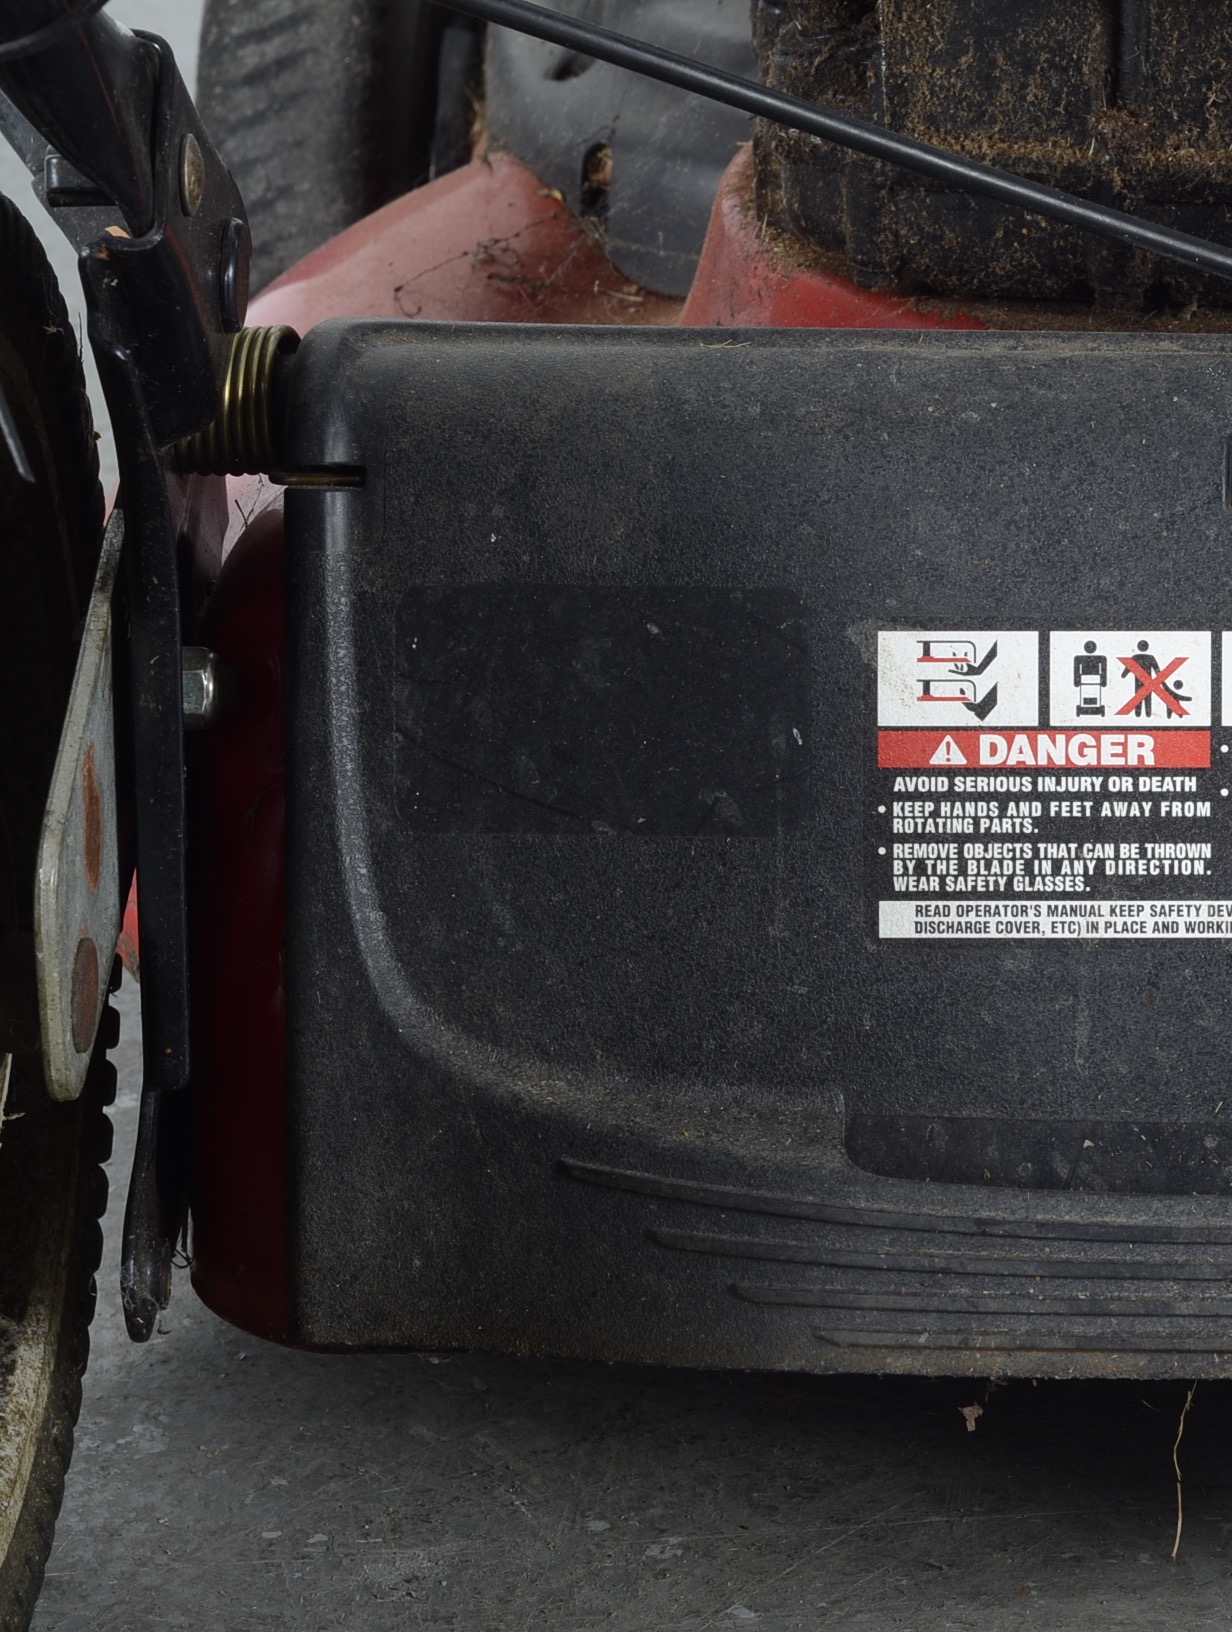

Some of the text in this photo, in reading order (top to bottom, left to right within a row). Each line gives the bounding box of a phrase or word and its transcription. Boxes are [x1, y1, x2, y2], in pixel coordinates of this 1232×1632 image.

[980, 734, 1155, 766] DANGER
[894, 776, 1196, 792] AVOID SERIOUS INJURY OR DEATH
[893, 801, 1210, 817] KEEP HANDS AND FEET AWAY FROM
[893, 818, 1038, 833] ROTATING PARTS.
[893, 843, 1211, 859] REMOVE OBJECTS THAT CAN BE THROWN
[893, 859, 1211, 875] BY THE BLADE IN ANY DIRECTION.
[893, 876, 1090, 891] WEAR SAFETY GLASSES.
[916, 905, 950, 917] READ
[957, 905, 1041, 917] OPERATOR'S
[1048, 905, 1103, 917] MANUAL
[1110, 905, 1144, 917] KEEP
[1151, 905, 1201, 917] SAFETY
[915, 921, 990, 934] DISCHARGE
[996, 921, 1044, 934] COVER,
[1052, 921, 1080, 936] ETC)
[1087, 921, 1098, 933] IN
[1105, 921, 1146, 933] PLACE
[1153, 922, 1178, 933] AND
